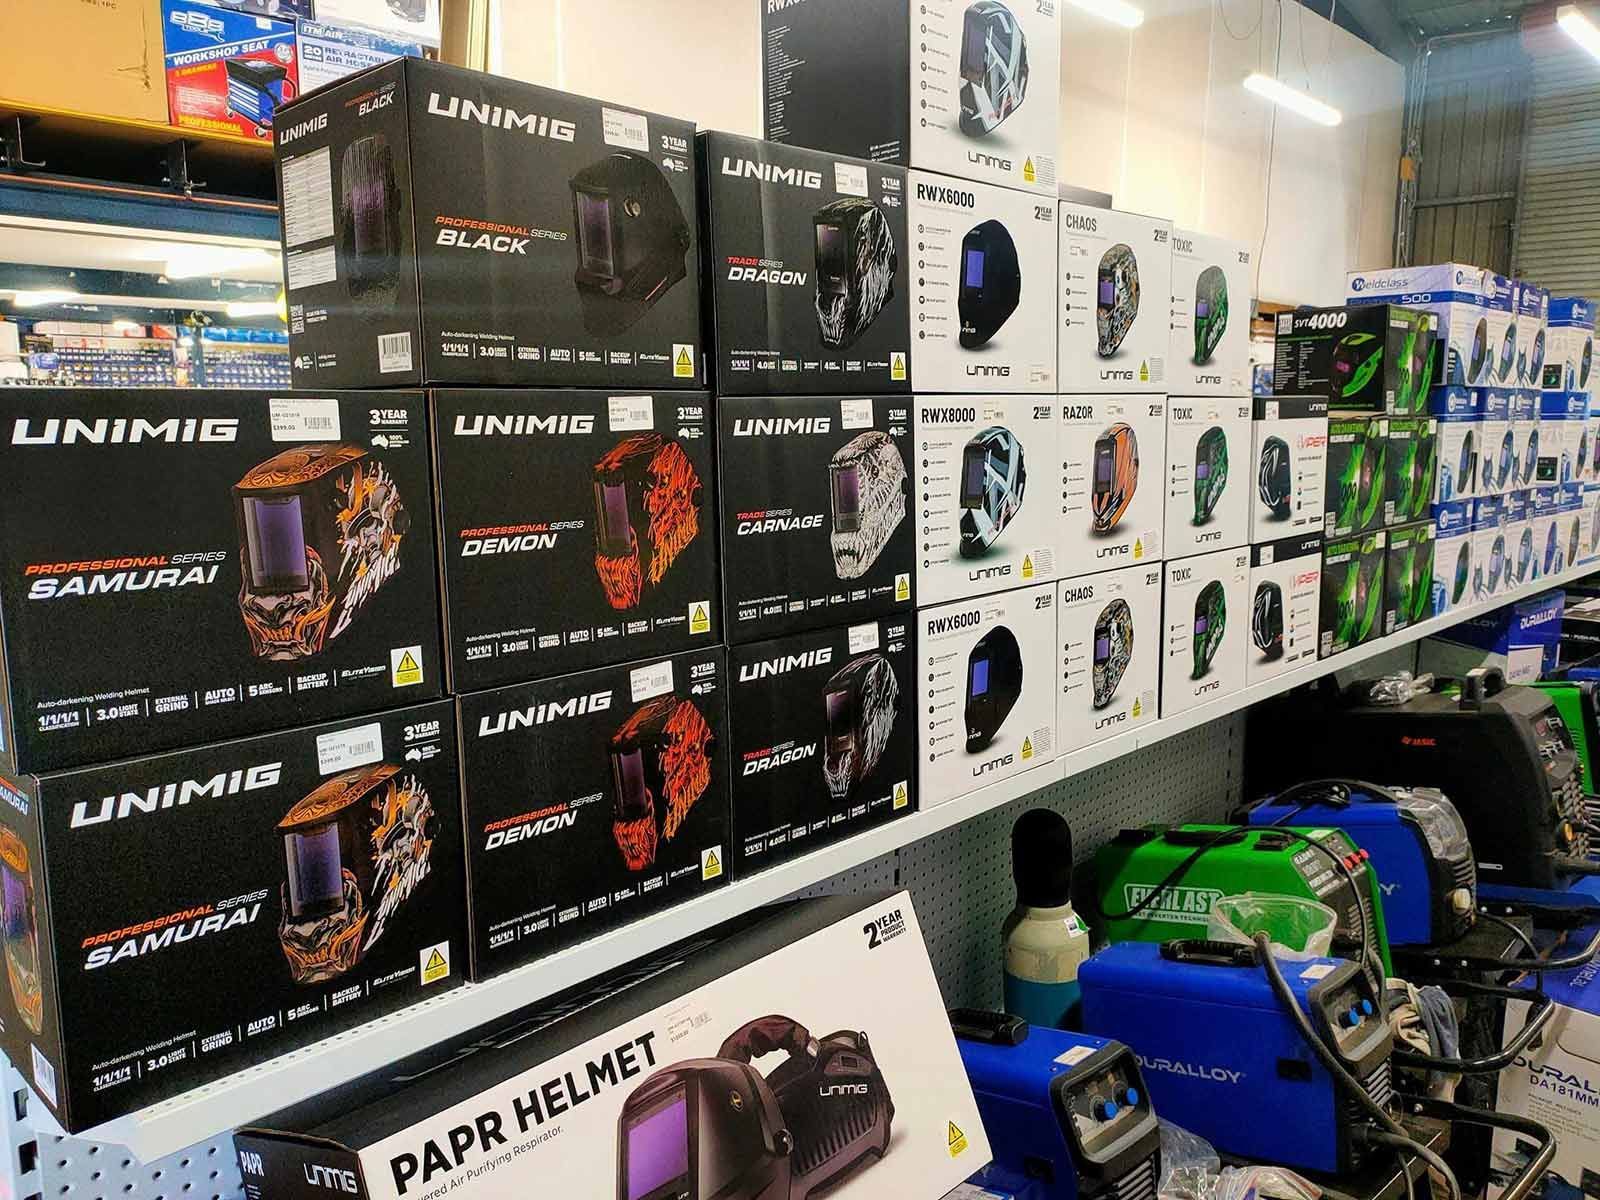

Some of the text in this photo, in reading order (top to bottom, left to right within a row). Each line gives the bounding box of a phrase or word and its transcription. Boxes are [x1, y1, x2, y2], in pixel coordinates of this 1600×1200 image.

[174, 40, 270, 66] WORKSHOP SEAT
[303, 44, 321, 55] 20
[326, 55, 342, 65] AIR
[359, 91, 394, 116] BLACK
[428, 92, 576, 143] UNIMIG
[280, 113, 328, 146] UNIMIG
[662, 135, 687, 149] 3 YEAR
[968, 151, 1011, 171] UNIMIG
[722, 157, 822, 190] UNIMIG
[881, 177, 887, 189] 3
[917, 183, 975, 208] RWX6000
[1034, 206, 1040, 220] 2
[435, 216, 568, 241] PROFESSIONAL SERIES
[1066, 214, 1097, 232] CHAOS
[436, 228, 530, 255] BLACK
[1153, 229, 1159, 241] 2
[1172, 238, 1193, 253] TOXIC
[727, 256, 784, 269] TRADE SERIES
[727, 267, 807, 286] DRAGON
[1352, 277, 1409, 291] Weldclass
[1402, 293, 1431, 303] 500
[442, 342, 469, 352] 1/1/1/1
[479, 347, 495, 356] 3.0
[550, 349, 570, 358] AUTO
[518, 352, 540, 360] GRIND
[579, 351, 585, 360] 5
[966, 365, 1010, 377] UNIMIG
[1100, 369, 1134, 381] UNIMIG
[1195, 375, 1222, 385] UNIMIG
[369, 409, 407, 425] 3 YEAR
[677, 407, 703, 420] 3 YEAR
[888, 409, 894, 420] 3
[921, 407, 976, 423] RWX8000
[1033, 407, 1039, 420] 2
[1063, 406, 1093, 420] RAZOR
[1149, 405, 1155, 416] 2
[1173, 407, 1193, 421] TOXIC
[11, 418, 240, 445] UNIMIG
[454, 415, 595, 436] UNIMIG
[733, 417, 831, 436] UNIMIG
[736, 508, 793, 520] TRADE SERIES
[460, 520, 585, 538] PROFESSIONAL SERIES
[737, 514, 824, 536] CARNAGE
[1195, 530, 1222, 544] UNIMIG
[461, 533, 557, 557] DEMON
[1097, 544, 1129, 558] UNIMIG
[25, 551, 227, 576] PROFESSIONAL SERIES
[969, 564, 1011, 582] UNIMIG
[1146, 574, 1151, 585] 2
[1171, 567, 1192, 582] TOXIC
[28, 565, 219, 600] SAMURAI
[1064, 586, 1094, 603] CHAOS
[1035, 597, 1041, 609] 2
[927, 610, 981, 636] RWX6000
[569, 630, 589, 641] AUTO
[597, 628, 603, 638] 5
[887, 628, 893, 638] 3
[466, 645, 492, 656] 1/1/1/1
[502, 643, 516, 653] 3.0
[539, 638, 560, 648] GRIND
[690, 662, 715, 678] 3 YEAR
[739, 647, 833, 682] UNIMIG
[297, 673, 327, 683] BACKUP
[297, 680, 329, 691] BATTERY
[204, 687, 235, 702] AUTO
[248, 682, 273, 697] 5 ARC
[1194, 680, 1220, 696] UNIMIG
[37, 687, 150, 709] Auto-darkening Welding Helmet
[155, 694, 188, 704] EXTERNAL
[96, 704, 138, 721] 3.0 LIGHT
[119, 709, 139, 718] STATE
[155, 701, 189, 713] GRIND
[478, 690, 613, 737] UNIMIG
[38, 711, 79, 726] 1/1/1/1
[1095, 711, 1127, 730] UNIMIG
[403, 720, 440, 741] 3 YEAR
[743, 748, 772, 761] TRADE
[743, 743, 817, 776] DRAGON
[972, 753, 1013, 777] UNIMIG
[70, 762, 282, 829] UNIMIG
[484, 792, 604, 833] PROFESSIONAL SERIES
[485, 810, 578, 851] DEMON
[588, 896, 607, 910] AUTO
[614, 892, 621, 901] 5
[81, 888, 268, 949] PROFESSIONAL SERIES
[558, 911, 579, 923] GRIND
[523, 922, 537, 934] 3.0
[863, 910, 902, 950] 2 YEAR
[880, 920, 905, 937] PRODUCT
[883, 927, 906, 942] WARRANTY
[84, 903, 262, 972] SAMURAI
[489, 930, 514, 945] 1/1/1/1
[332, 985, 360, 1000] BACKUP
[332, 991, 362, 1007] BATTERY
[287, 1003, 311, 1021] 5 ARC
[247, 1015, 275, 1032] AUTO
[201, 1030, 232, 1045] EXTERNAL
[202, 1036, 233, 1053] GRIND
[92, 1030, 196, 1071] Auto-darkening Welding Helmet
[147, 1047, 186, 1072] 3.0 LIGHT
[168, 1053, 187, 1064] STATE
[93, 1065, 131, 1087] 1/1/1/1
[1512, 1056, 1600, 1094] DURAL
[819, 1084, 868, 1097] UNIMIG
[389, 1030, 660, 1196] PAPR HELMET
[240, 1151, 264, 1177] PAPR
[450, 1126, 564, 1191] Air Purifying Respirator.
[304, 1162, 358, 1195] UNIMIG
